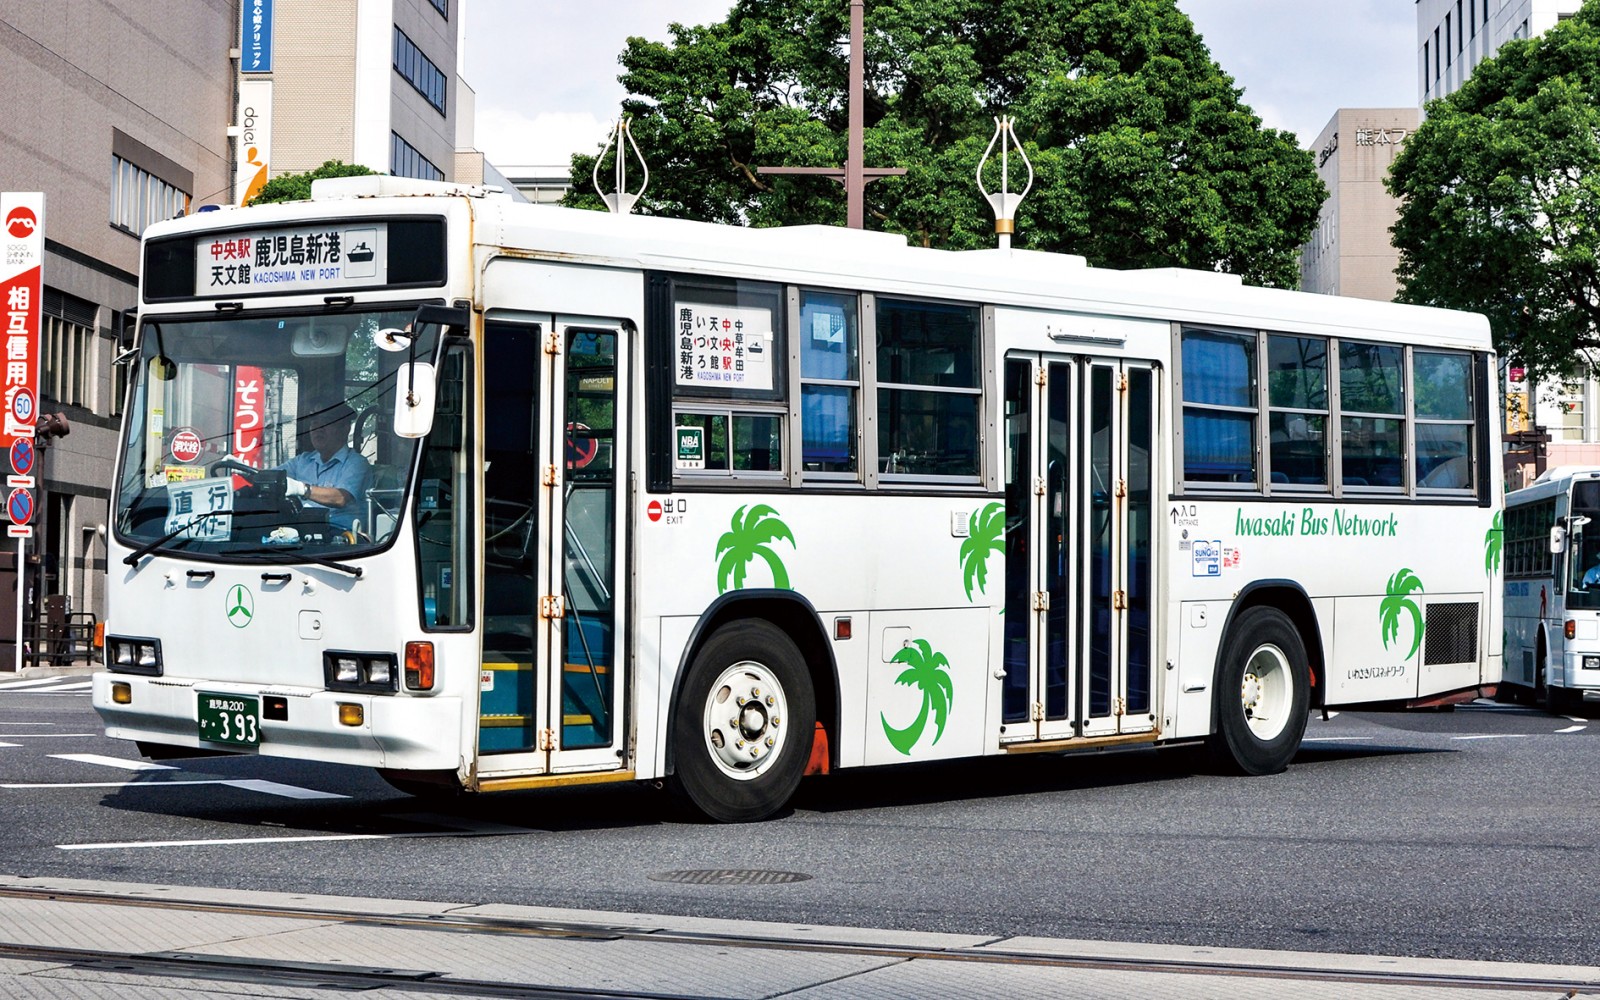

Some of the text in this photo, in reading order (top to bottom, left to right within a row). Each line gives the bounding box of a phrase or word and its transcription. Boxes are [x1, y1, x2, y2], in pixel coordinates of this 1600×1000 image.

[243, 107, 258, 146] daiei
[1355, 127, 1416, 146] 熊本フ
[210, 232, 341, 268] 中央駅 鹿児島新港
[210, 264, 251, 286] 天文館
[253, 267, 341, 283] KAGOSHIMA NEW PORT
[679, 307, 694, 380] 鹿児島新港
[696, 316, 706, 369] いづろ
[709, 317, 719, 370] 天文館
[722, 318, 732, 370] 中央駅
[734, 319, 744, 371] 中草牟田
[697, 371, 745, 382] KAGOSHIMA NEW PORT
[17, 397, 30, 415] 50
[174, 440, 199, 453] 消火栓
[681, 435, 699, 448] NBA
[663, 498, 687, 513] 出口
[1181, 504, 1197, 517] 入口
[666, 516, 683, 524] EXIT
[1179, 518, 1199, 526] ENTRANCE
[1235, 507, 1398, 536] Iwasaki Bus Network
[1347, 665, 1405, 679] いわさきバスネットワーク
